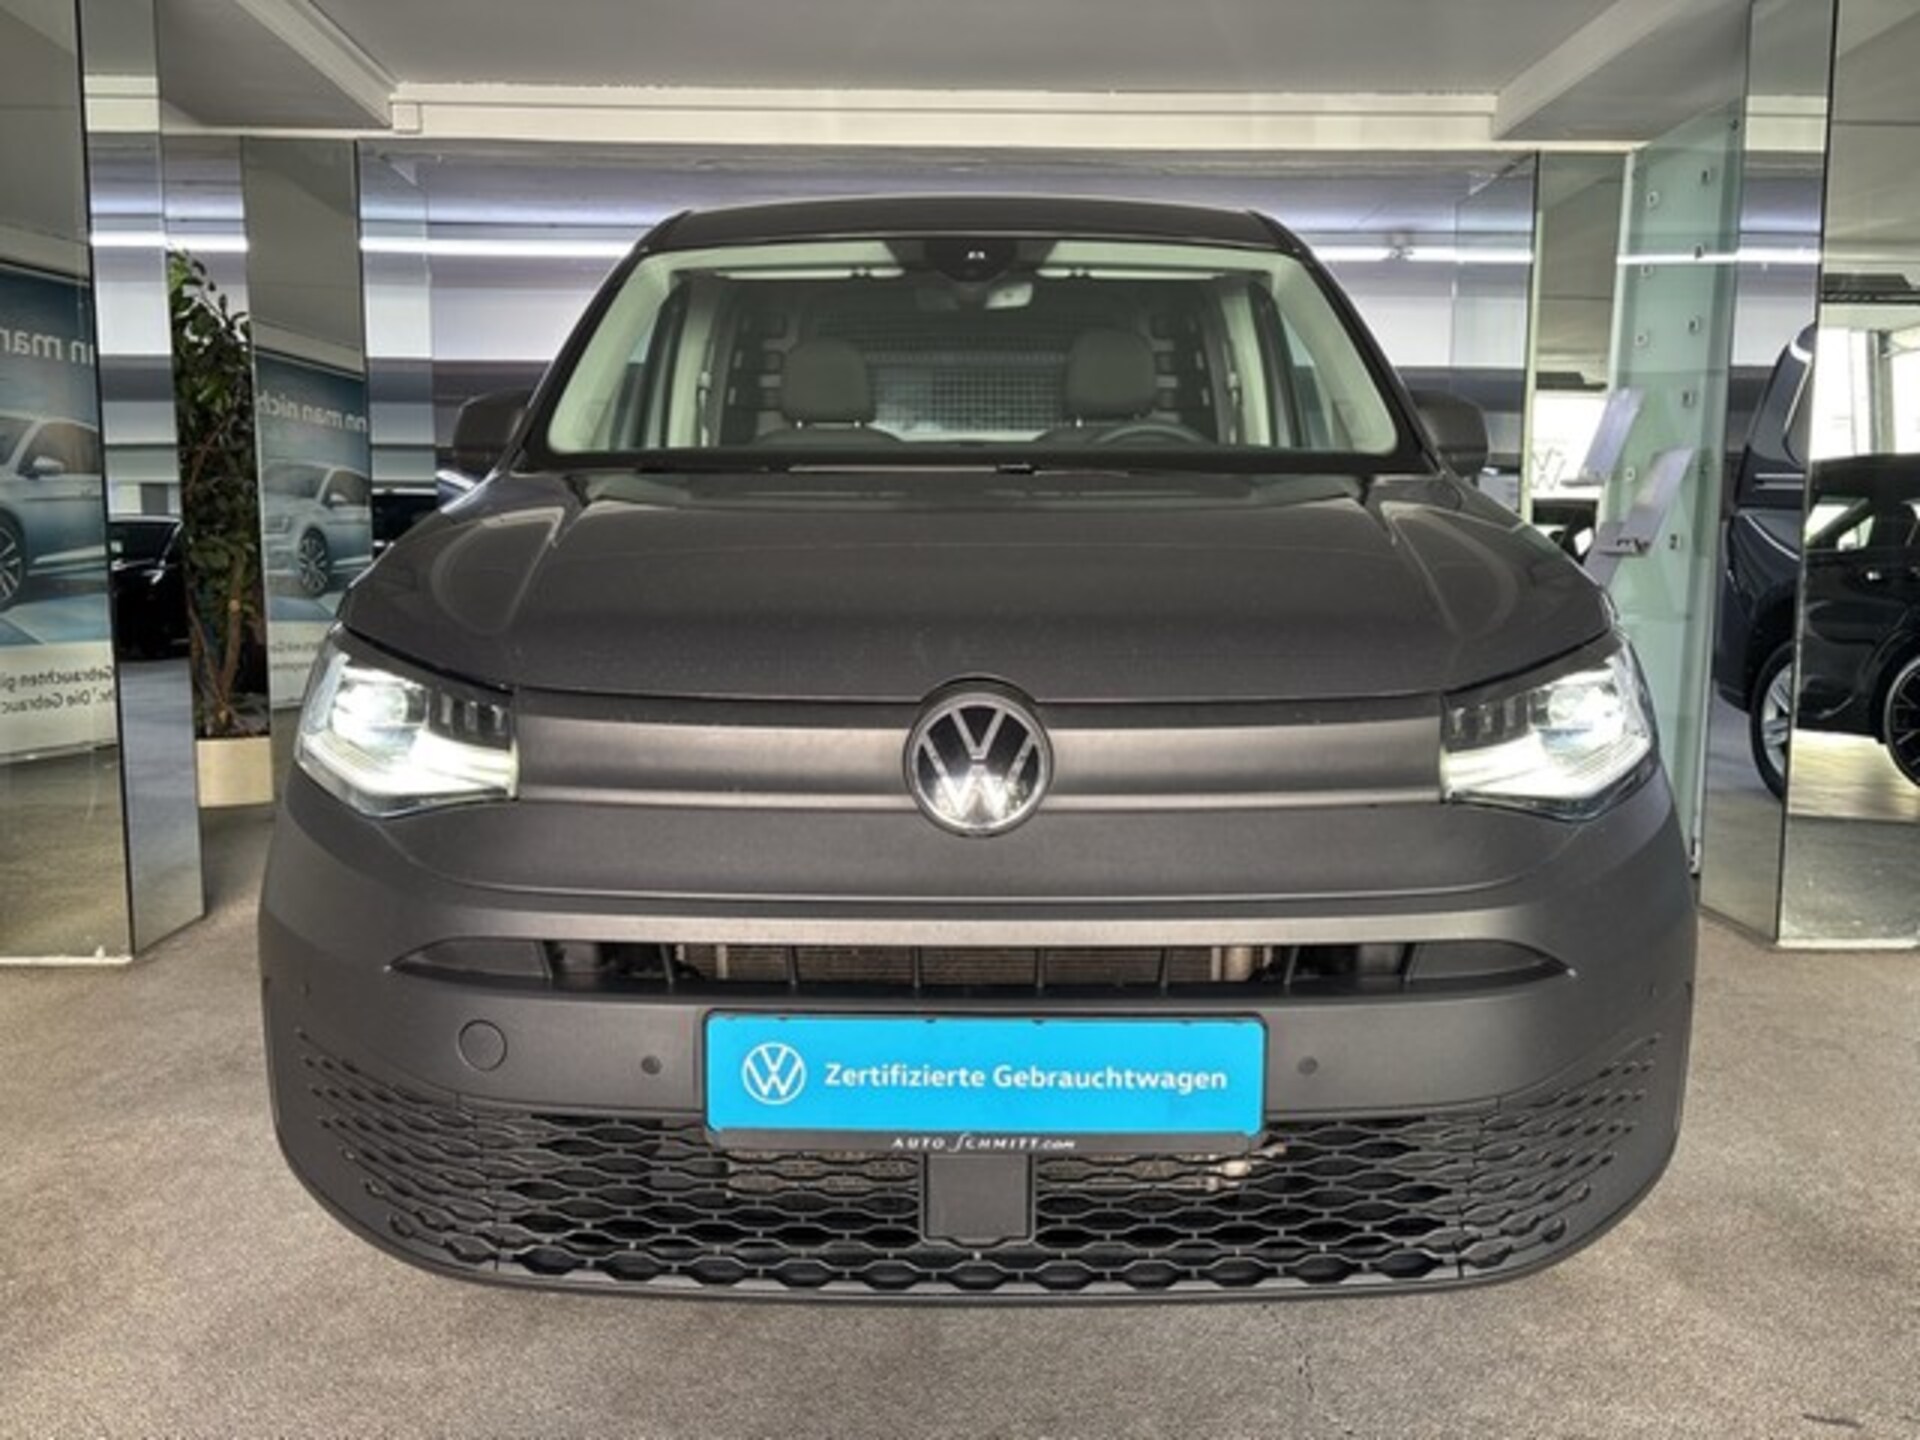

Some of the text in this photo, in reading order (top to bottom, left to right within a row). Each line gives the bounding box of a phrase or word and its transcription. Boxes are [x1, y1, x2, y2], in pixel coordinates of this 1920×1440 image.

[914, 697, 1042, 827] VW
[824, 1063, 985, 1088] Zertifizierte
[992, 1064, 1228, 1096] Gebrauchtwagen
[891, 1136, 946, 1150] AUTO
